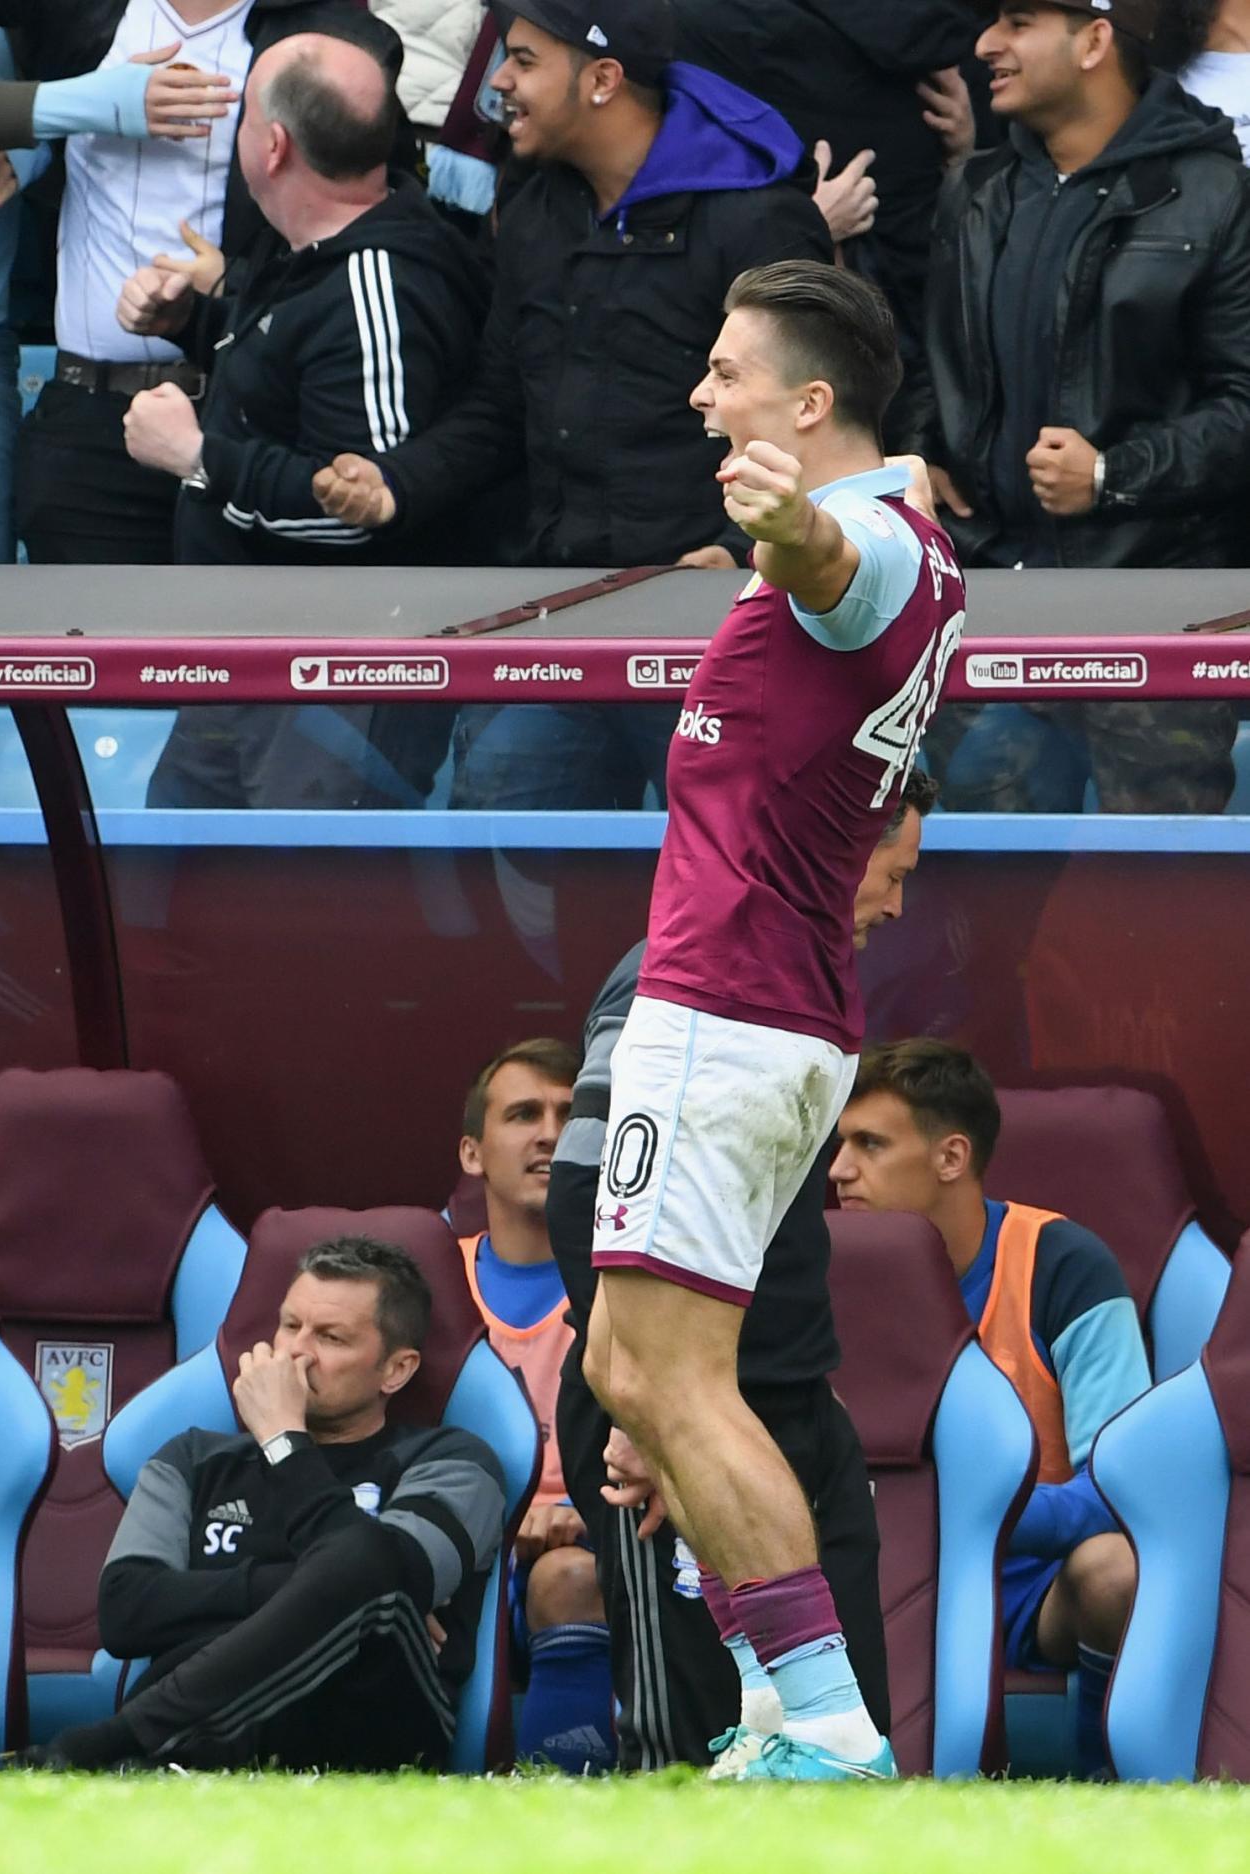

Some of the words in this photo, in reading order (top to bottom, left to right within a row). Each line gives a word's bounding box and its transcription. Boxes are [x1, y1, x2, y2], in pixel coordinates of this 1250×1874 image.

[139, 664, 230, 683] #avfclive
[333, 664, 439, 683] avfcofficial
[493, 663, 583, 682] #avfclive
[1029, 661, 1138, 680] avfcofficial
[675, 702, 722, 744] oks
[607, 1113, 658, 1199] 0
[46, 1350, 104, 1367] AVFC
[203, 1522, 243, 1555] SC
